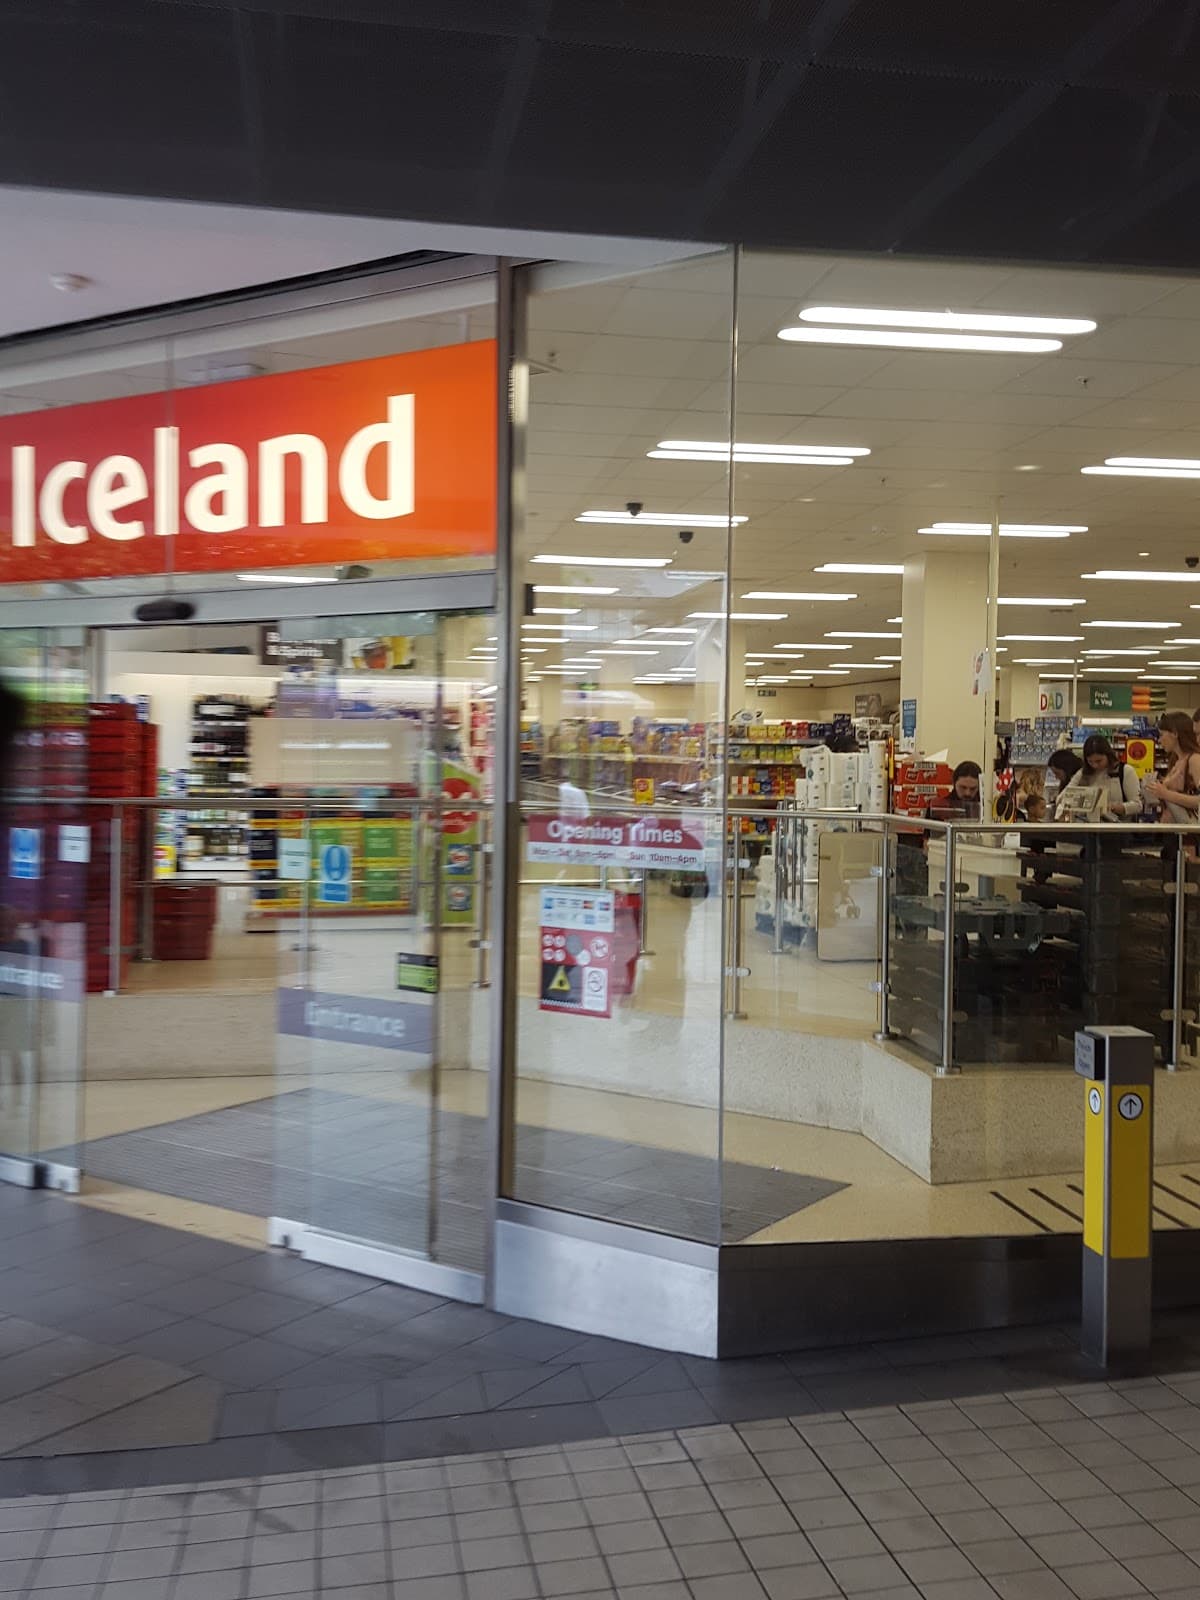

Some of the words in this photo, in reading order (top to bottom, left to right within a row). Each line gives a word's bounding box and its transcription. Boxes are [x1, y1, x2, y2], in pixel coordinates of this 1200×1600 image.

[11, 393, 416, 548] Iceland
[1040, 692, 1064, 711] DAD
[547, 819, 624, 843] Opening
[628, 821, 683, 844] Times
[629, 851, 646, 861] Sun
[304, 1000, 406, 1038] Entrance
